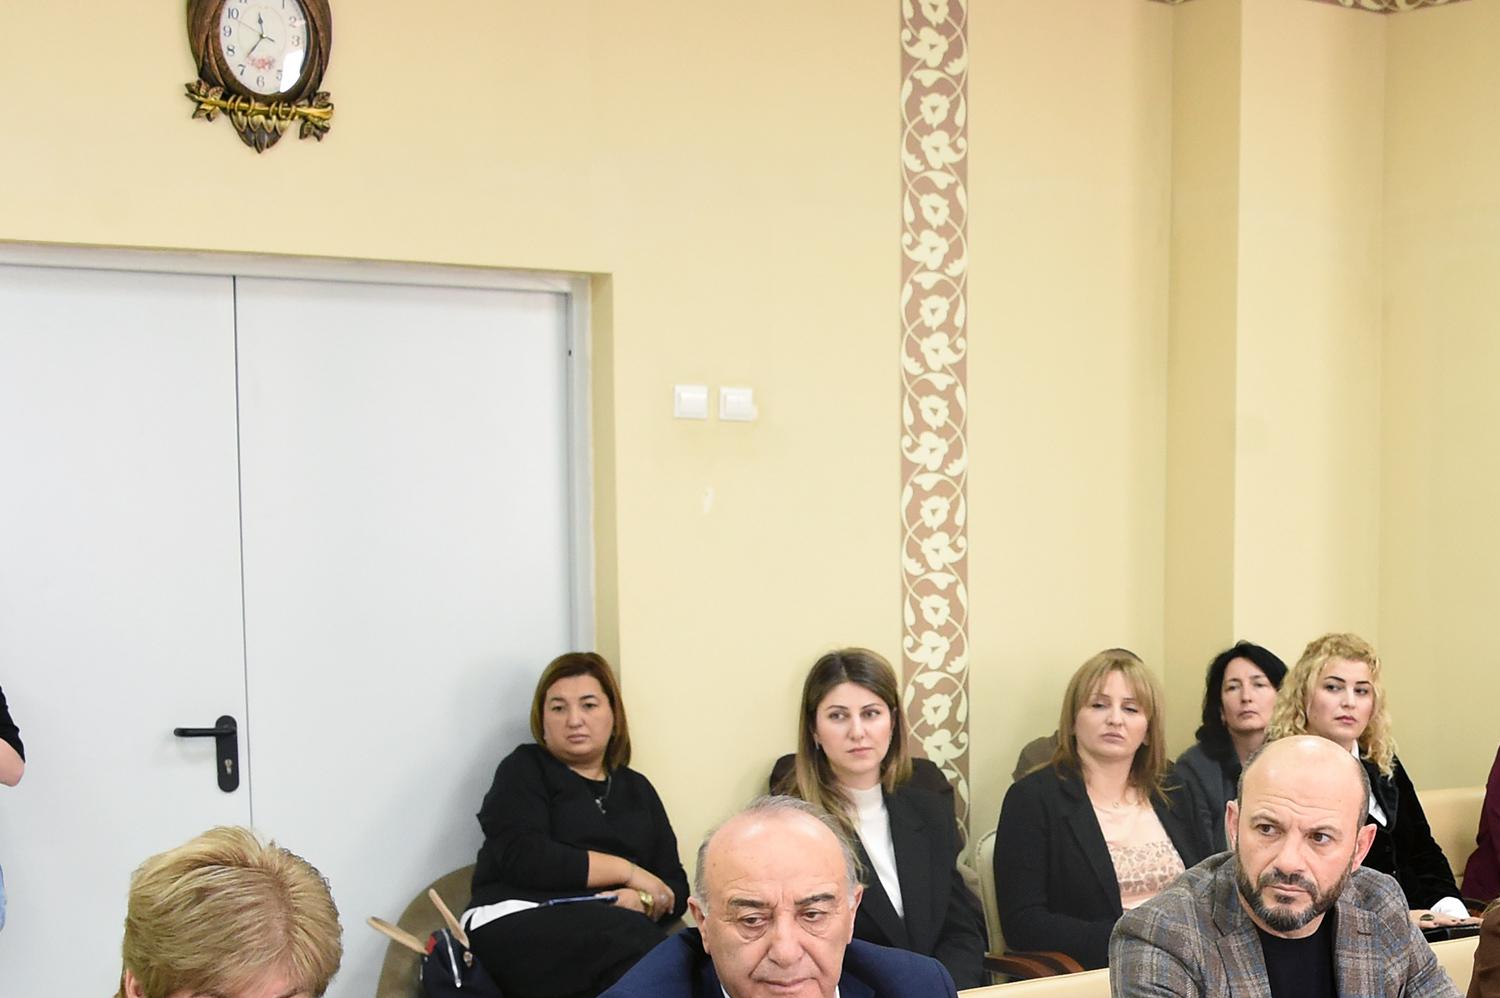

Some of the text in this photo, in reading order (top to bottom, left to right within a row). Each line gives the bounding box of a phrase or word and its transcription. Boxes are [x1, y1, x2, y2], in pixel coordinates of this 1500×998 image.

[228, 7, 240, 20] 10
[289, 15, 297, 29] 2
[223, 25, 232, 38] 9
[291, 35, 301, 47] 3
[226, 44, 236, 57] 8
[238, 63, 247, 76] 7
[256, 75, 265, 88] 6
